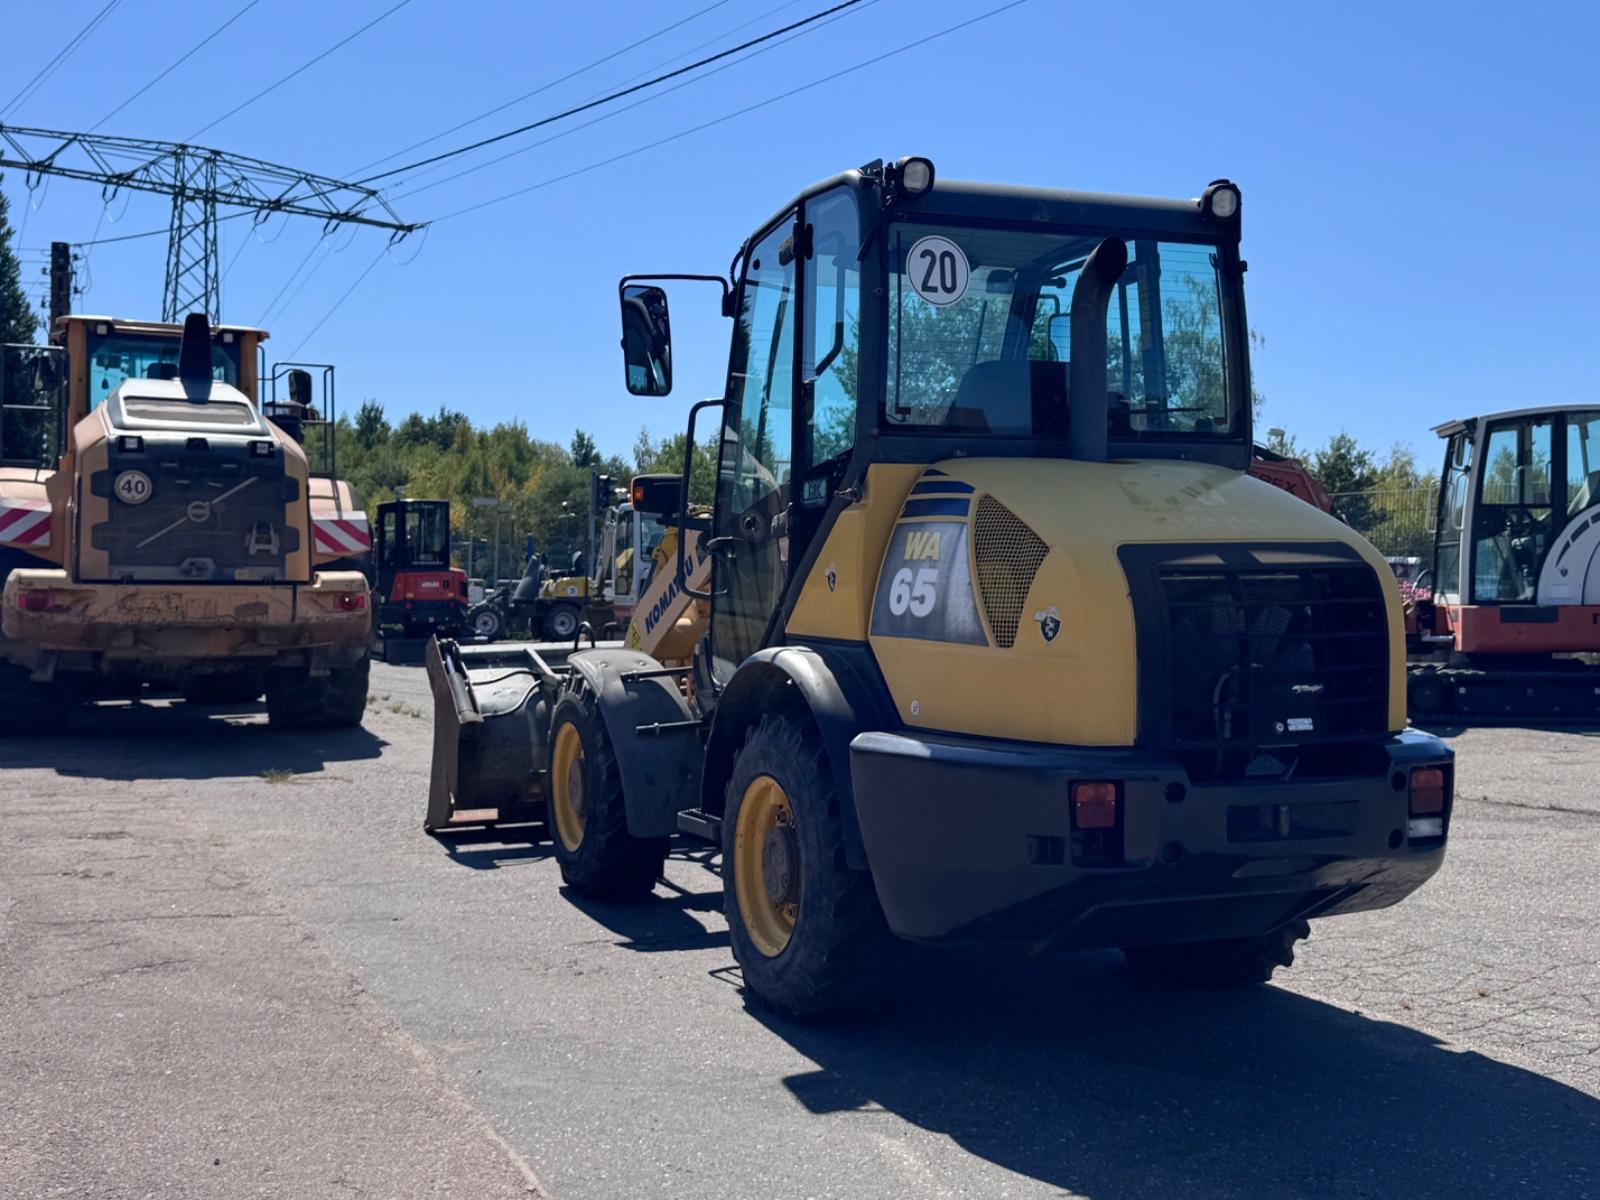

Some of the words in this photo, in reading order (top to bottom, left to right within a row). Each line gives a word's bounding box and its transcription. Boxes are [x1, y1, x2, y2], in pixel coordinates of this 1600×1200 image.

[920, 249, 957, 294] 20
[121, 480, 145, 495] 40
[904, 531, 941, 560] WA
[644, 554, 693, 634] KOMATU
[889, 567, 939, 618] 65
